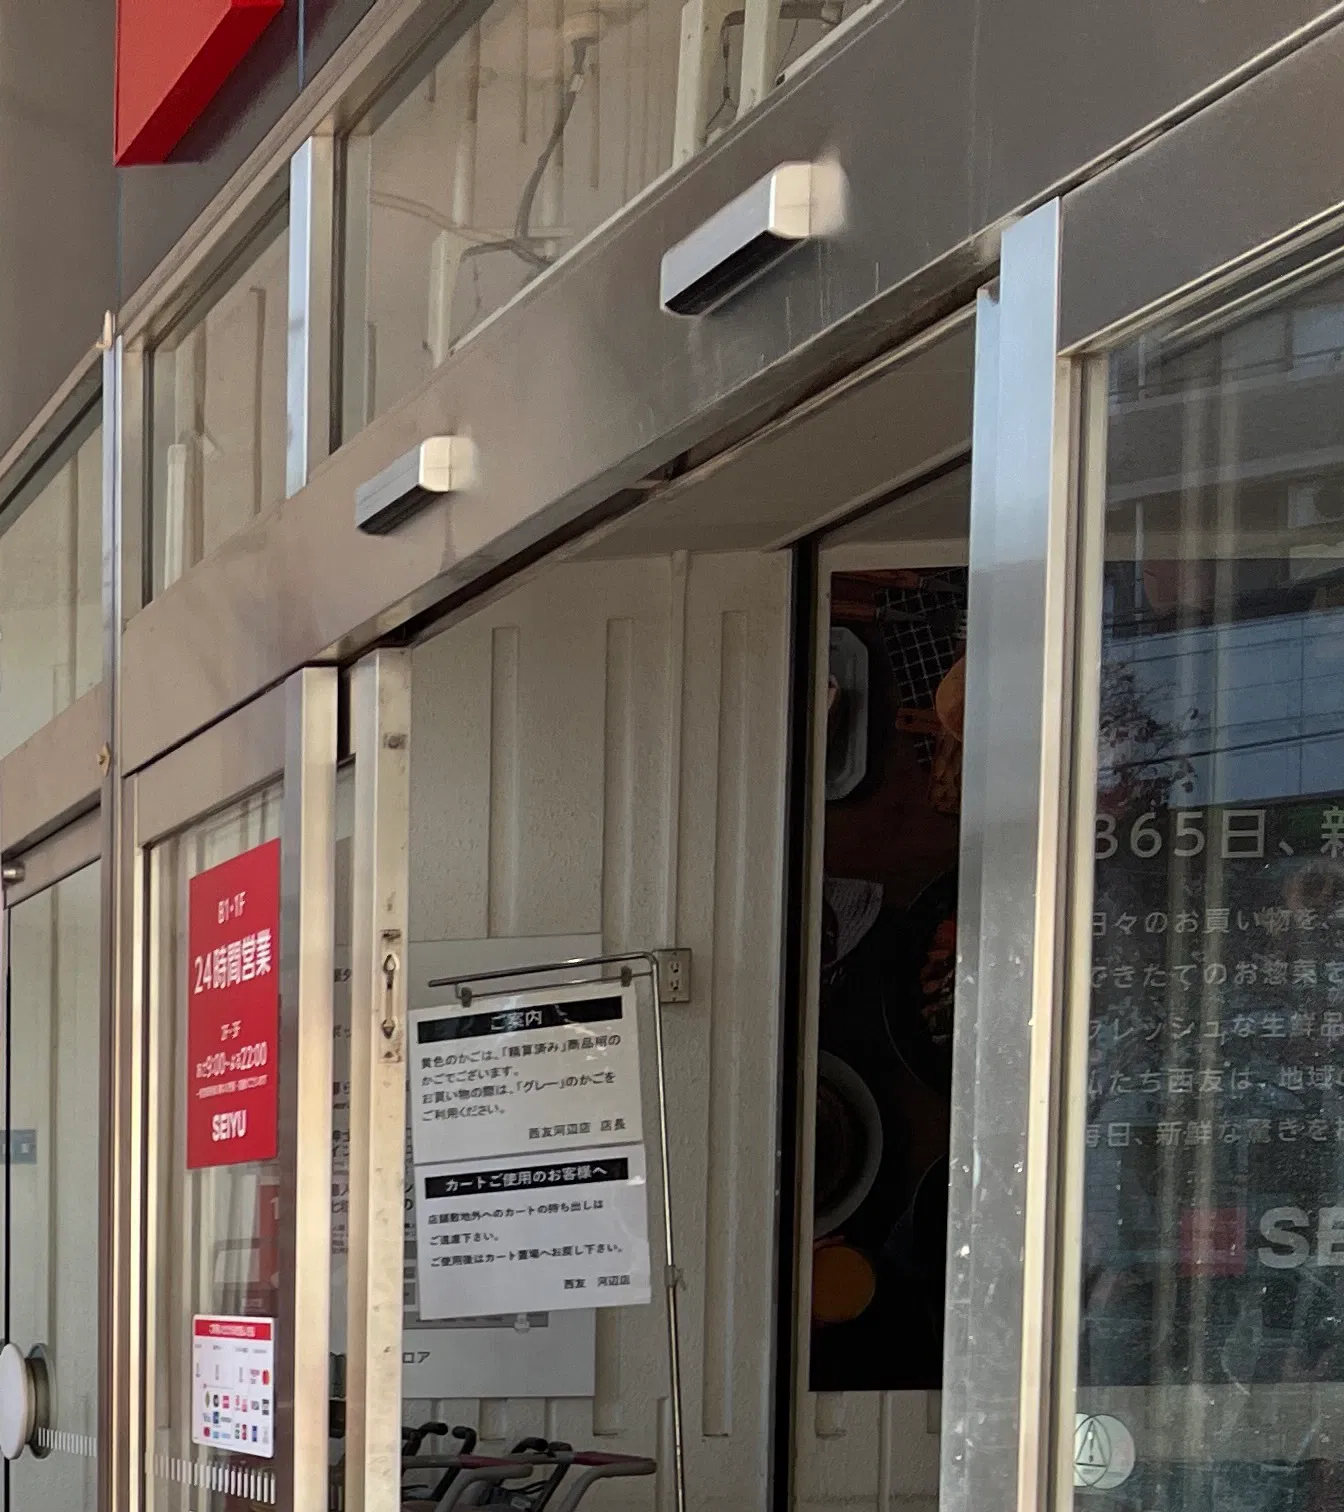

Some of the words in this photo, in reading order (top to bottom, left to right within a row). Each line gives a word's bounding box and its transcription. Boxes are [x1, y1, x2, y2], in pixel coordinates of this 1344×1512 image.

[194, 928, 272, 995] 24時間営業
[490, 1010, 543, 1031] ご案内
[212, 1109, 248, 1142] SEIYU
[446, 1165, 607, 1192] カートご使用のお客様へ
